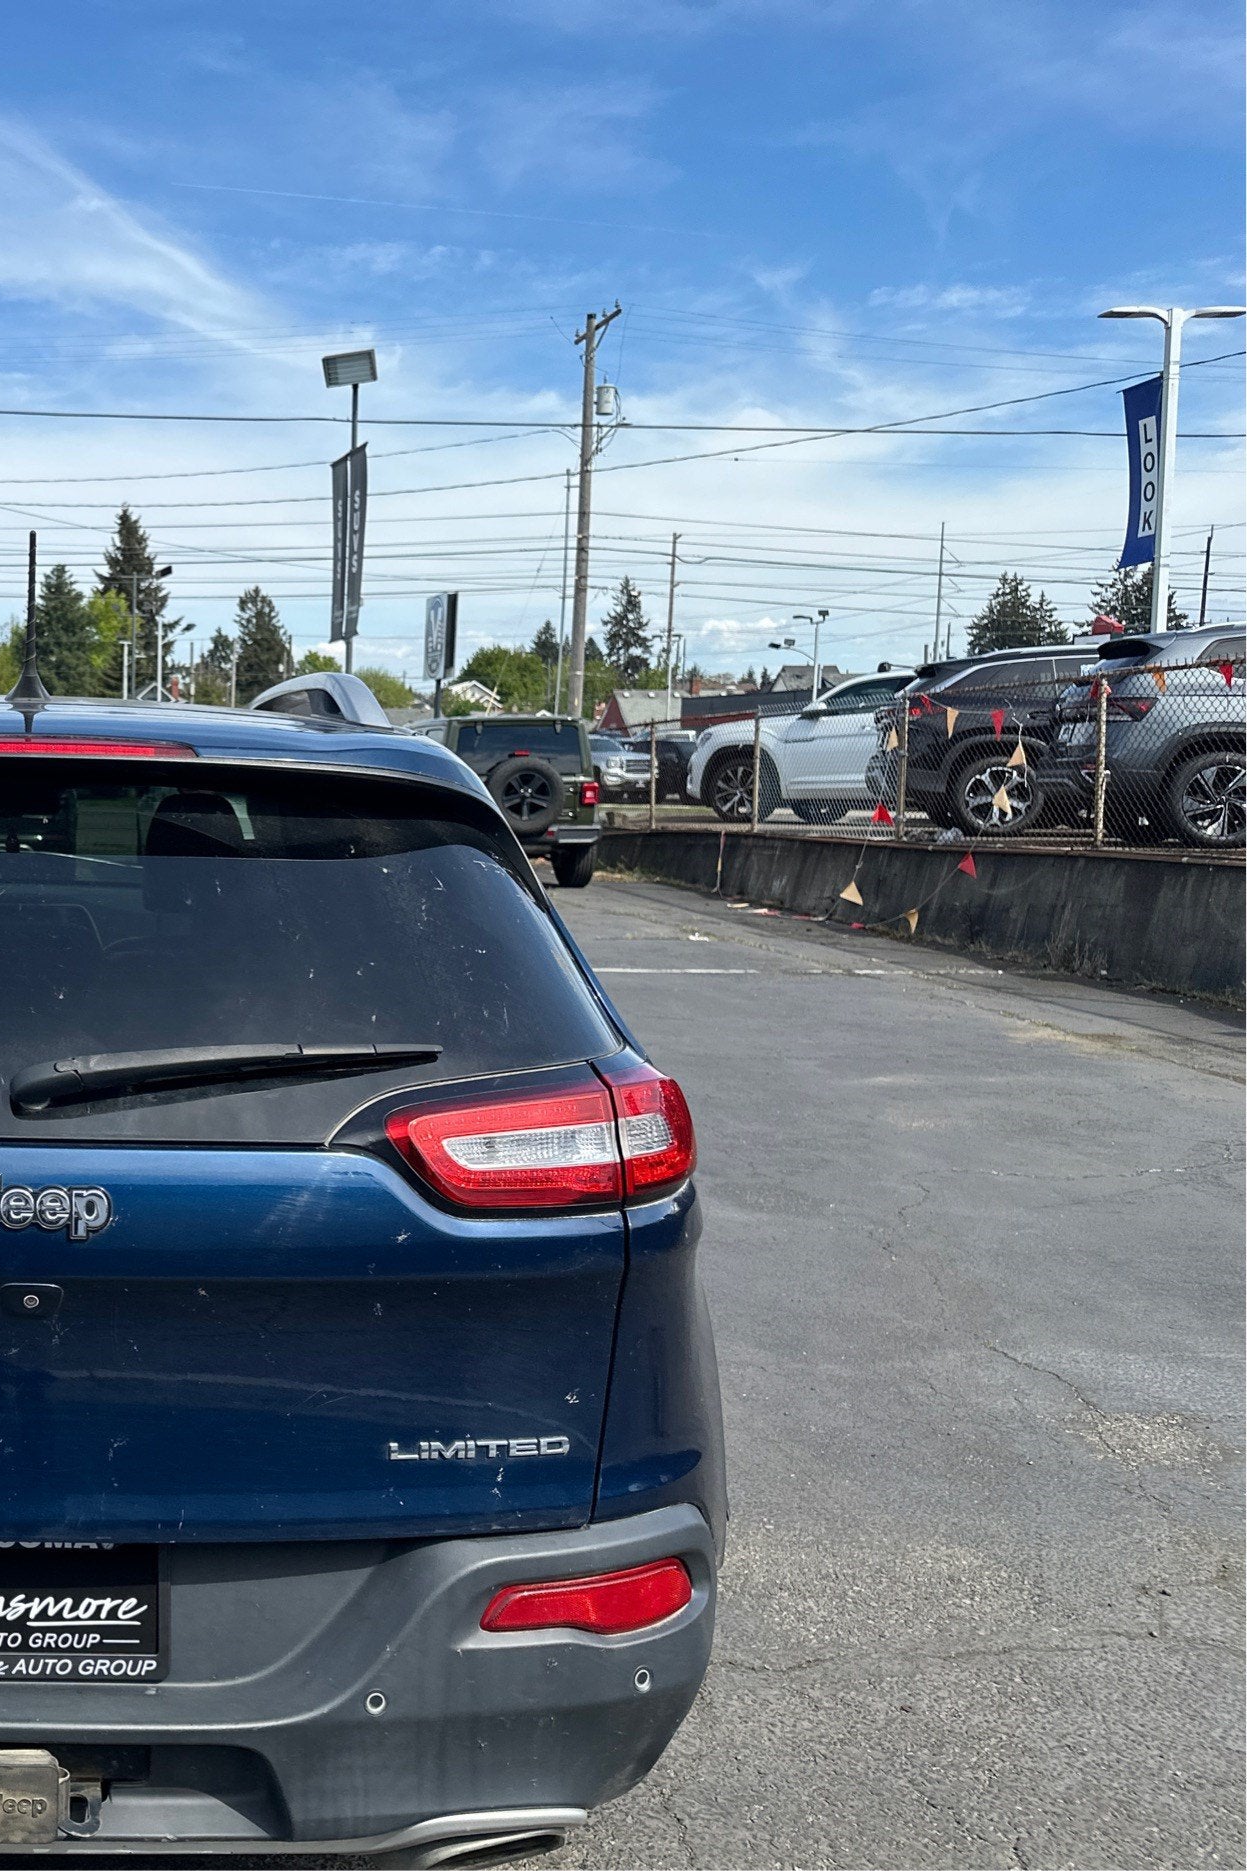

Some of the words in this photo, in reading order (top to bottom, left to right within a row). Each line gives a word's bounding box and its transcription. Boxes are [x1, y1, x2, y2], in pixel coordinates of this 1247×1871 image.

[1142, 422, 1156, 532] LOOK
[389, 1436, 570, 1460] LIMITED
[28, 1632, 101, 1649] GROUP
[11, 1659, 72, 1676] AUTO
[78, 1659, 157, 1676] GROUP
